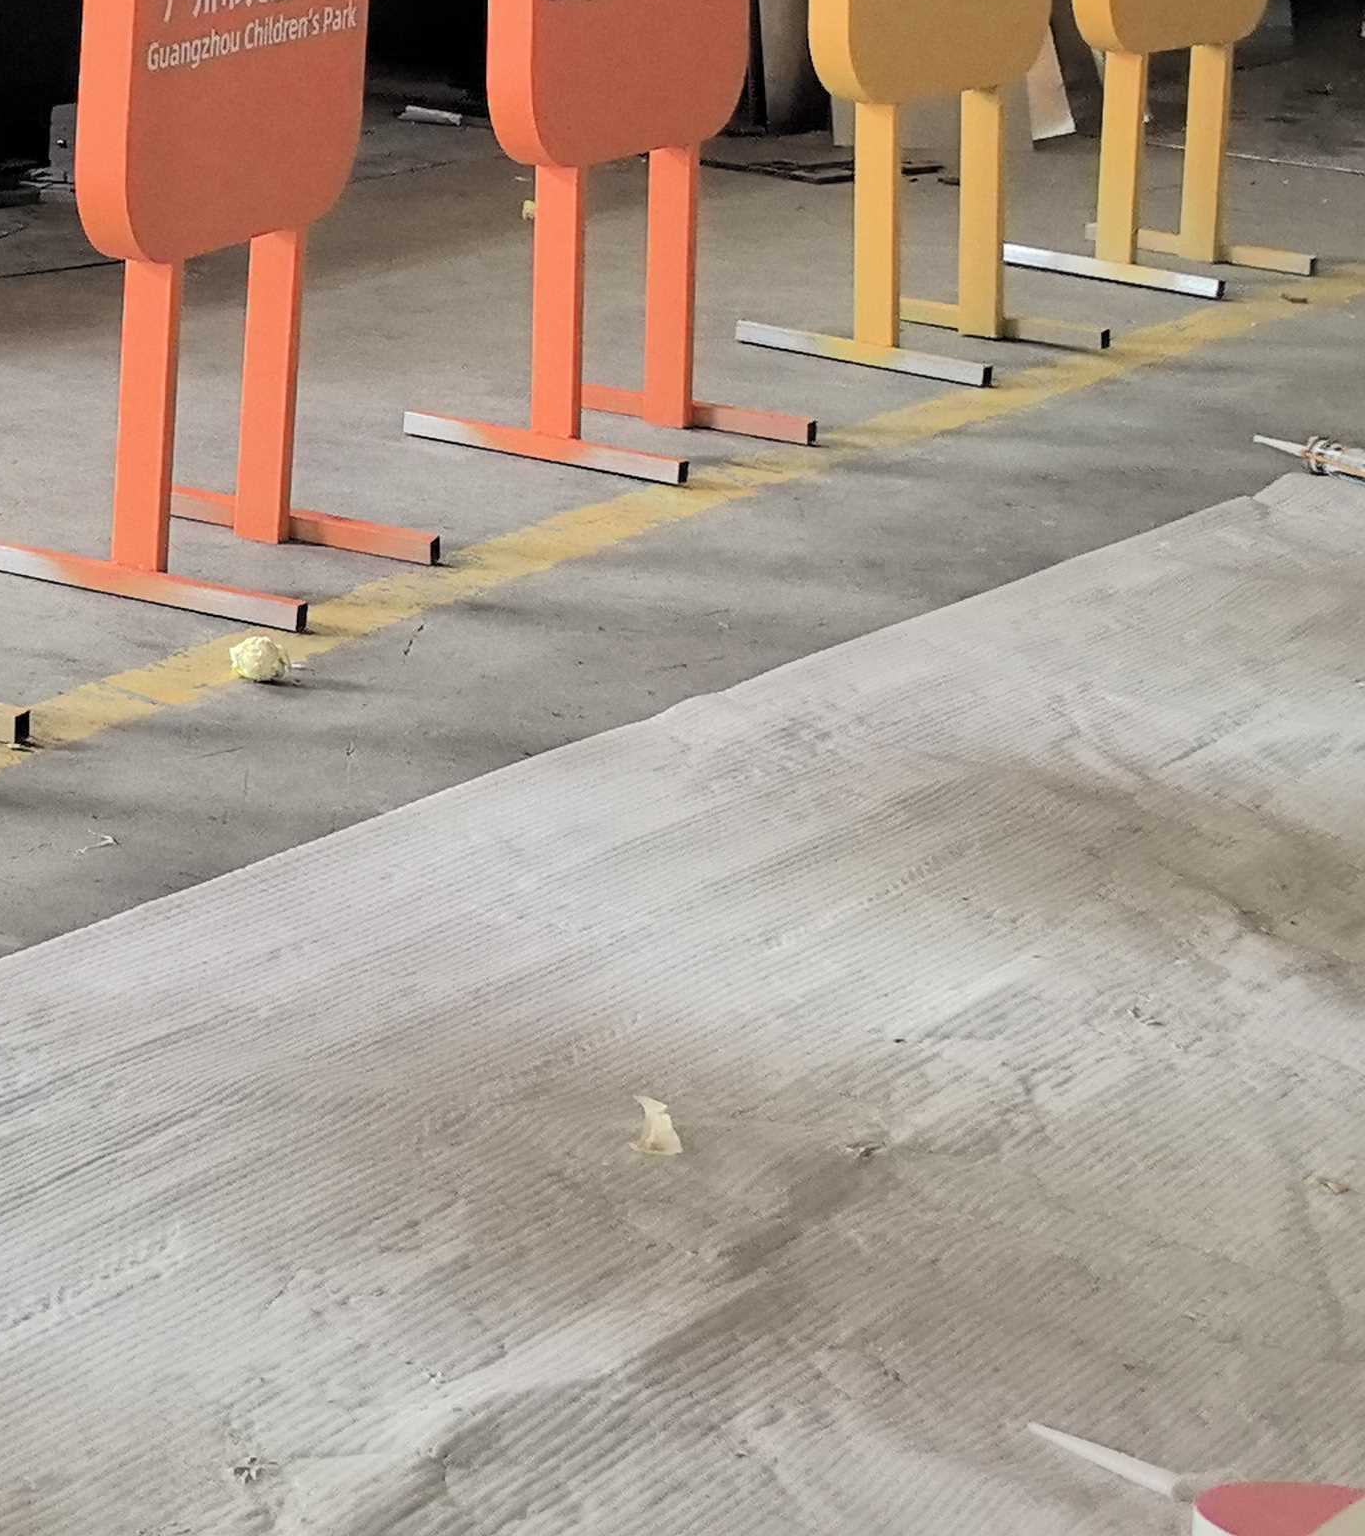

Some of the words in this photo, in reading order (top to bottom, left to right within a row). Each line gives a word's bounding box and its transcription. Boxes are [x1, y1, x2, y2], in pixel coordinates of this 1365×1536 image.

[147, 28, 240, 71] Guangzhou
[244, 8, 319, 49] Children's
[322, 0, 357, 34] Park
